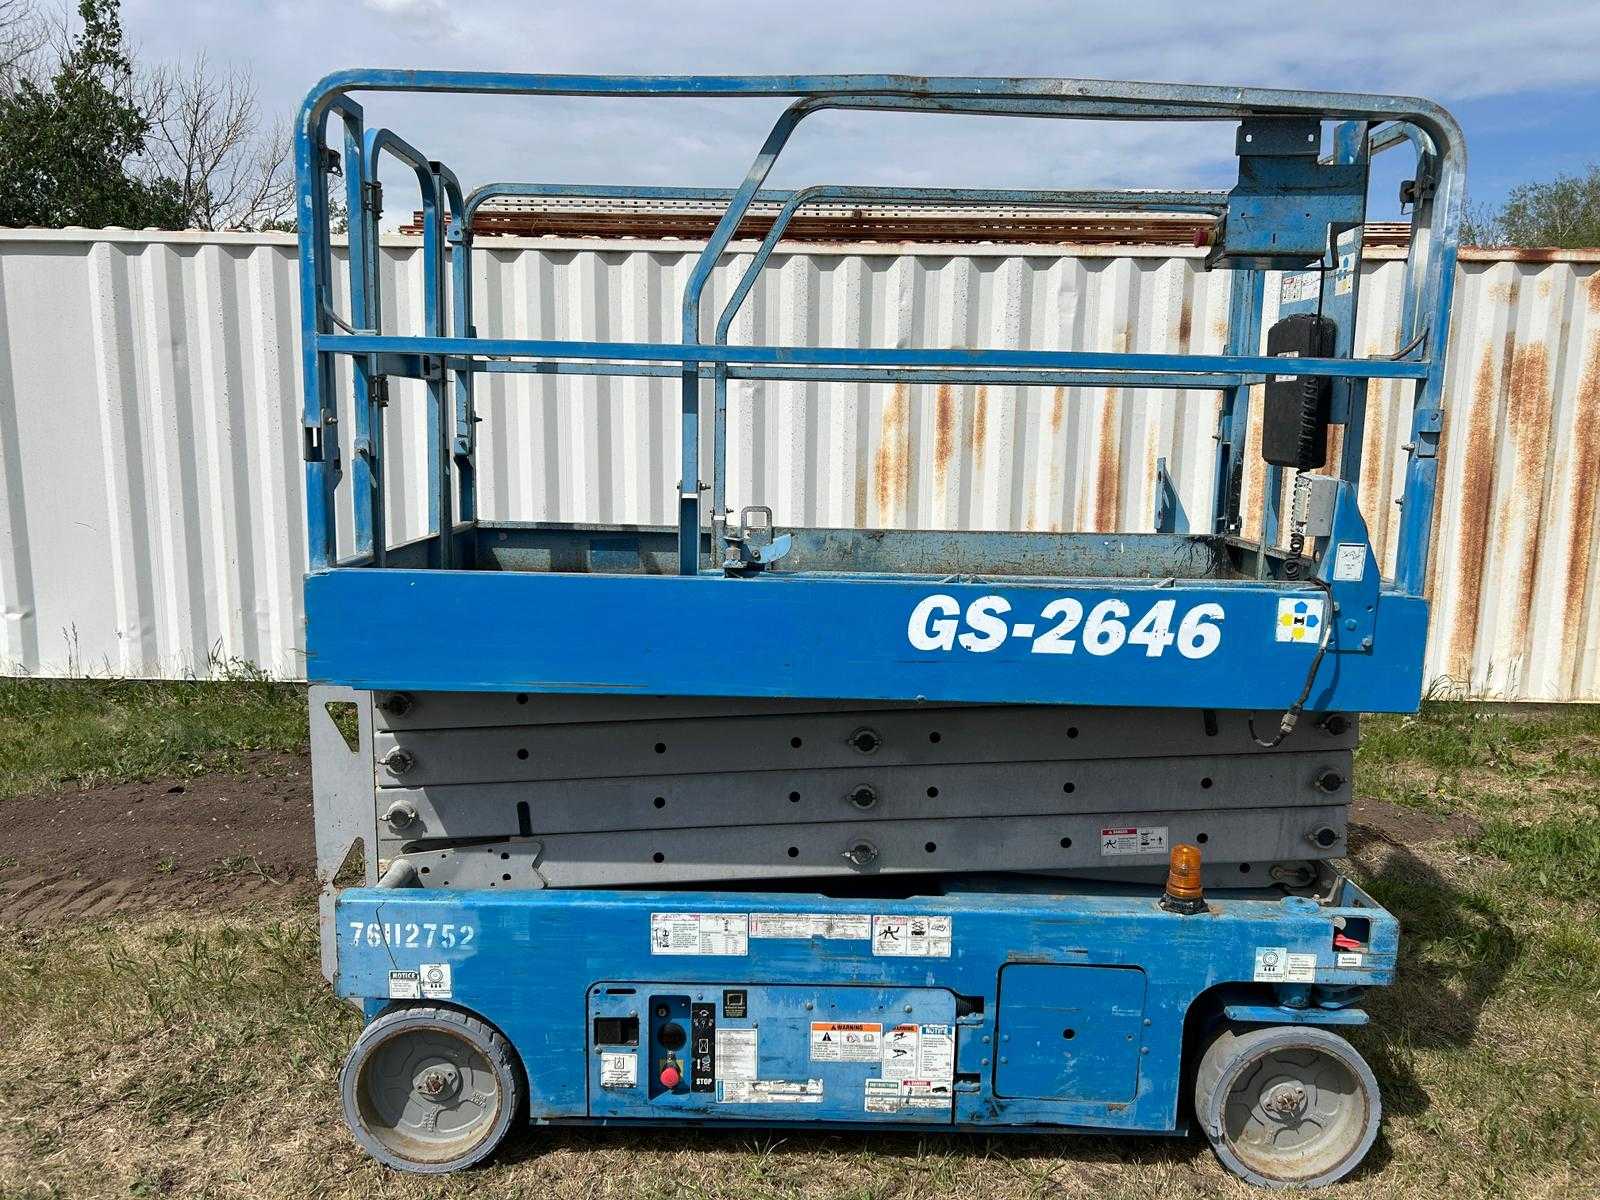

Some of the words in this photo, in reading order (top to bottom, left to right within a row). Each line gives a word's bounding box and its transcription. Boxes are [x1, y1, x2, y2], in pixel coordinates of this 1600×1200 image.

[907, 594, 1225, 659] GS-2646
[350, 922, 474, 950] 76112752
[392, 972, 416, 980] NOTICE
